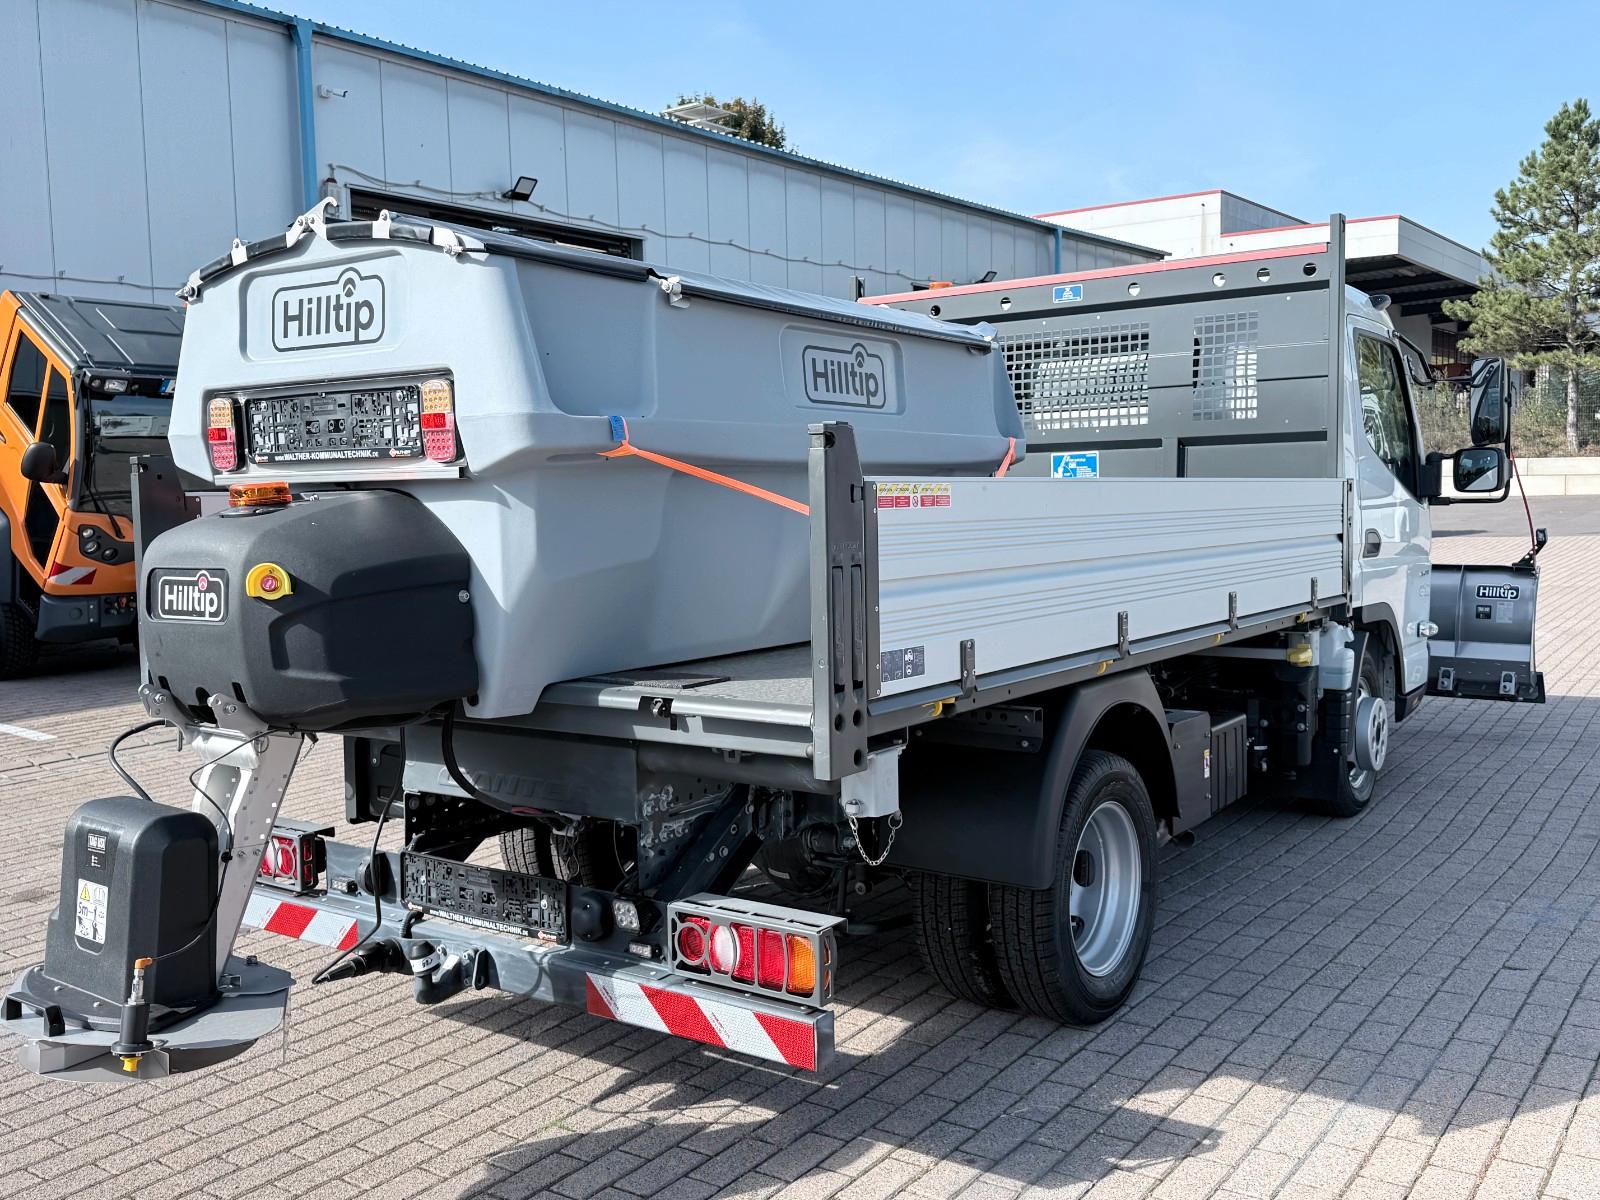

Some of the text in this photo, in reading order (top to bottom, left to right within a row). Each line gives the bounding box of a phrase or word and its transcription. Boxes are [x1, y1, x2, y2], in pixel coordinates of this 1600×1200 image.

[283, 279, 375, 342] Hilltip
[811, 352, 879, 405] Hilltip
[164, 577, 218, 618] Hilltip
[1479, 585, 1517, 599] Hilltip
